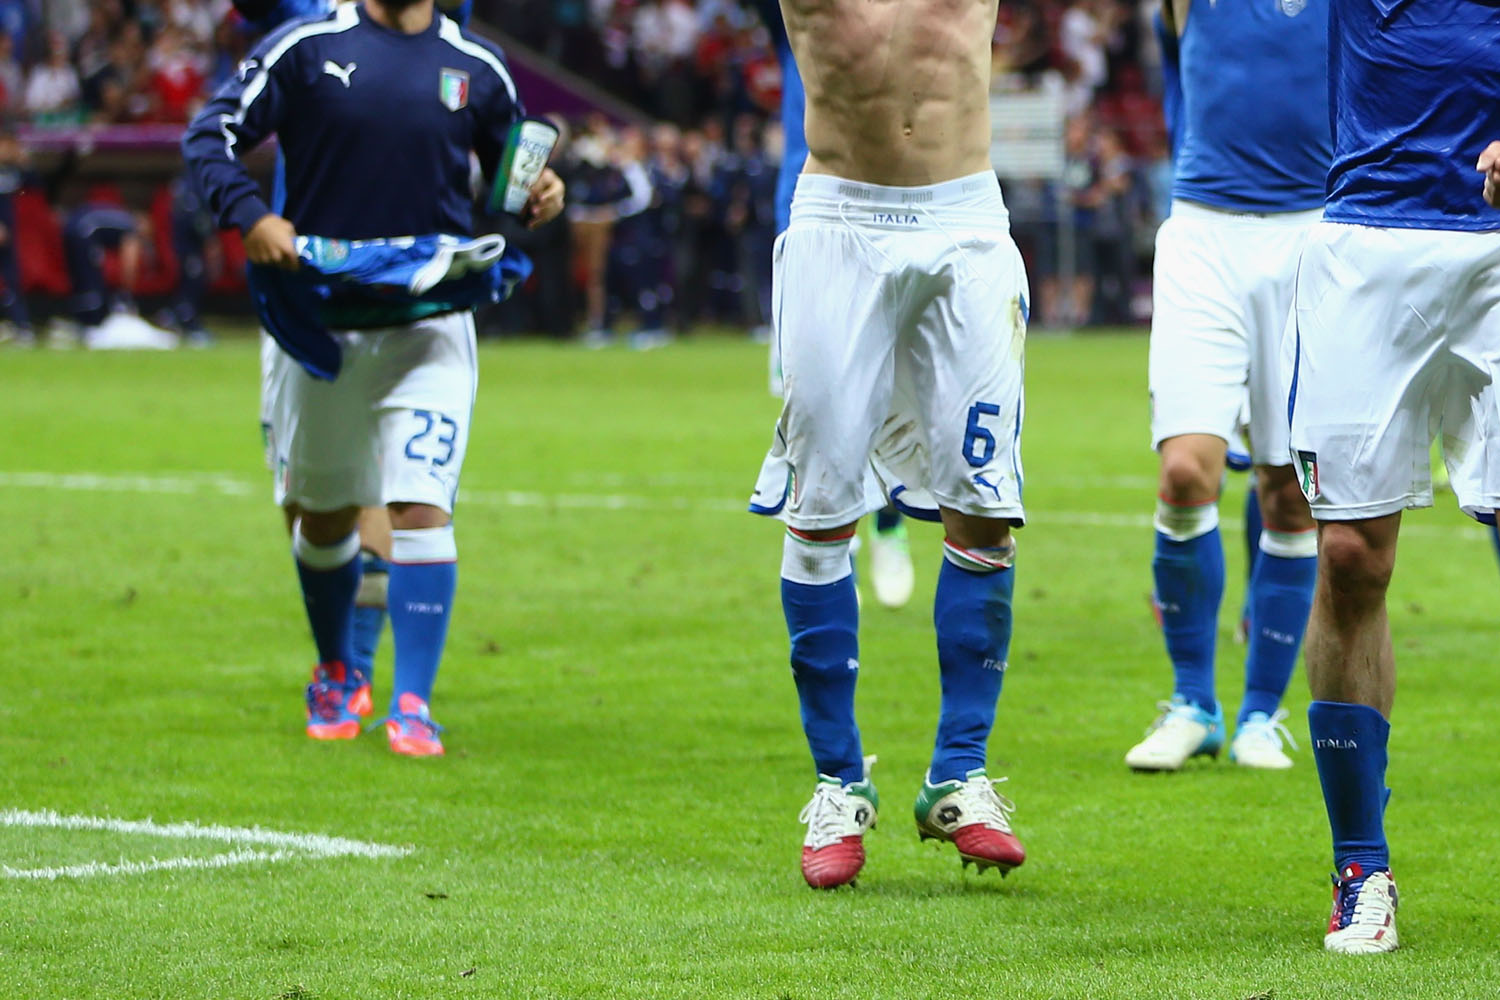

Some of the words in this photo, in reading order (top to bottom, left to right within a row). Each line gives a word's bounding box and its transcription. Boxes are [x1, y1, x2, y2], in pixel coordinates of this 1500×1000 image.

[873, 213, 919, 225] ITALIA
[404, 409, 458, 467] 23
[961, 401, 1000, 469] 6
[1316, 738, 1358, 750] ITALIA
